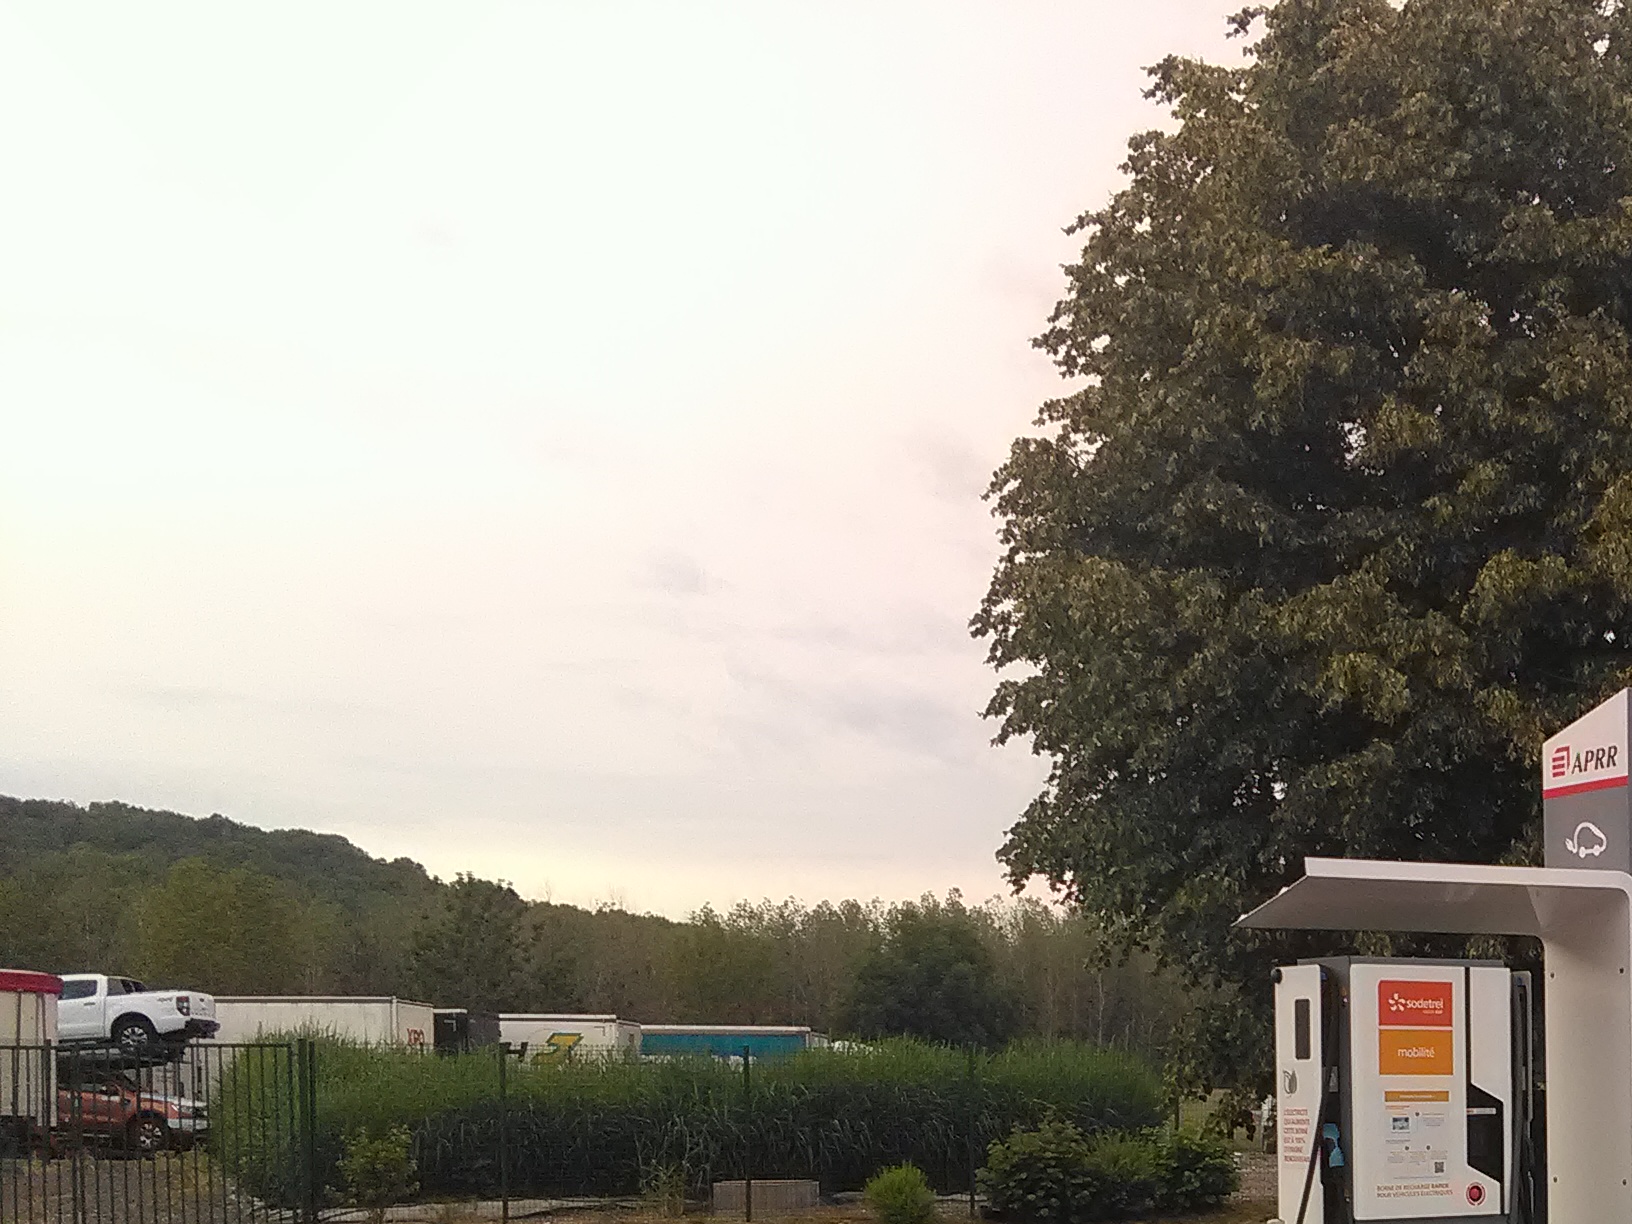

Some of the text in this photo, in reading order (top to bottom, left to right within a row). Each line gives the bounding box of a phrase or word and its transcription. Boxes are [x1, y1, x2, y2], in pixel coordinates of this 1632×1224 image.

[1571, 745, 1618, 775] APRR
[1406, 998, 1443, 1009] sodetrel
[1397, 1047, 1435, 1058] mobilité
